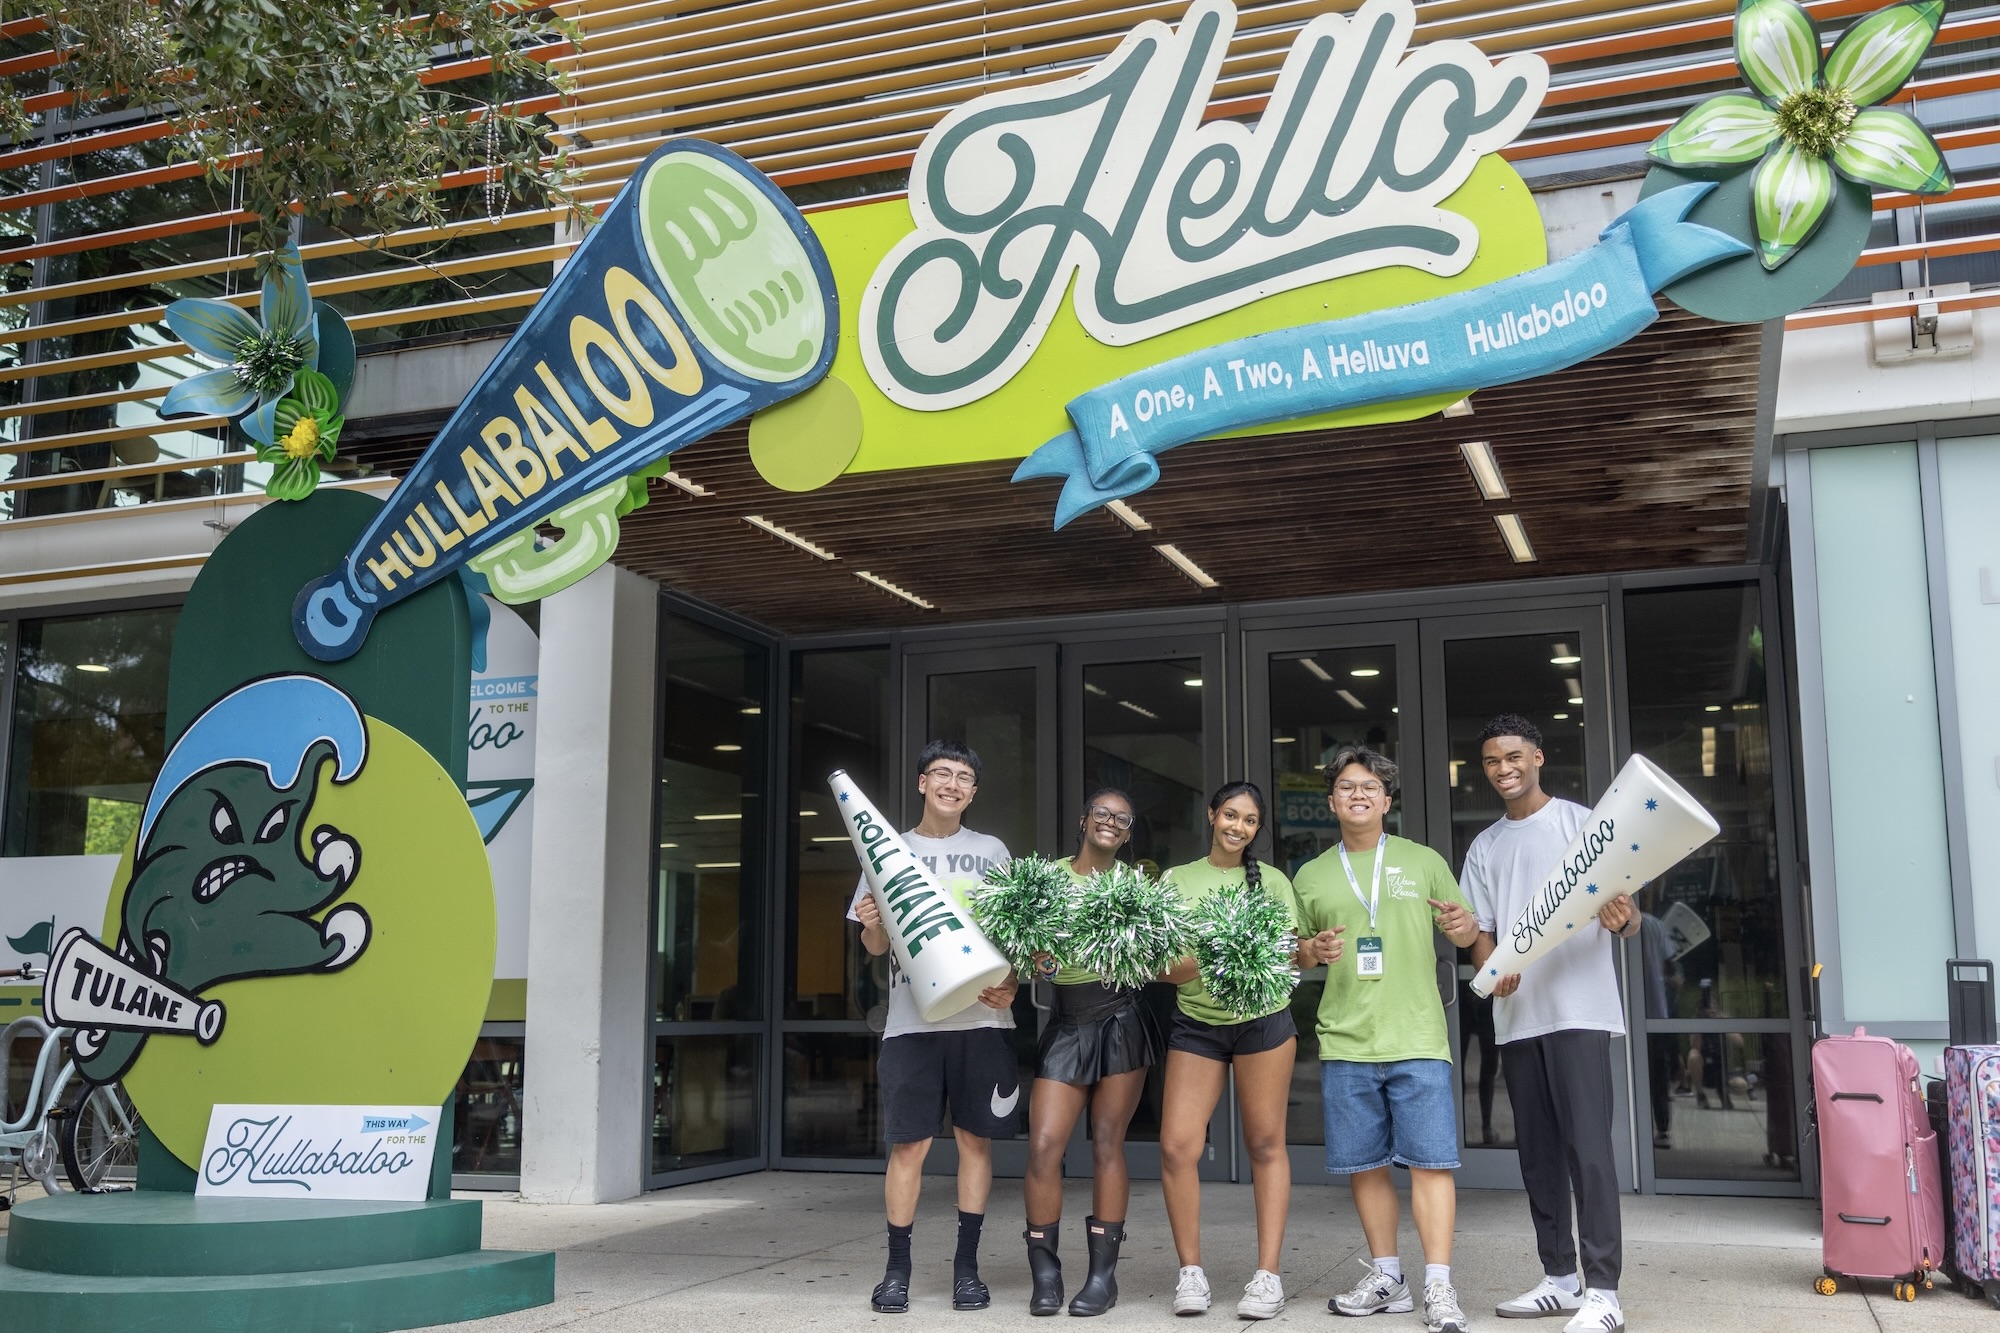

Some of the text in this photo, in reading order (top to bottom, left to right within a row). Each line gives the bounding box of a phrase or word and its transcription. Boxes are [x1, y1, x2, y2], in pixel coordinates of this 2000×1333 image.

[876, 11, 1527, 394] Hello
[1110, 282, 1608, 439] A One, A Two, A Helluva Hullabaloo
[366, 266, 703, 591] HULLABALOO
[470, 681, 526, 697] ELCOME
[489, 702, 529, 714] TO THE
[1287, 804, 1337, 820] BOO
[853, 810, 965, 959] ROLL WAVE
[946, 854, 995, 877] YOU
[1511, 818, 1615, 954] Hullabaloo
[71, 957, 183, 1023] TULANE
[205, 1115, 414, 1192] Hullabaloo
[366, 1119, 409, 1128] THIS WAY
[387, 1135, 427, 1144] FOR THE
